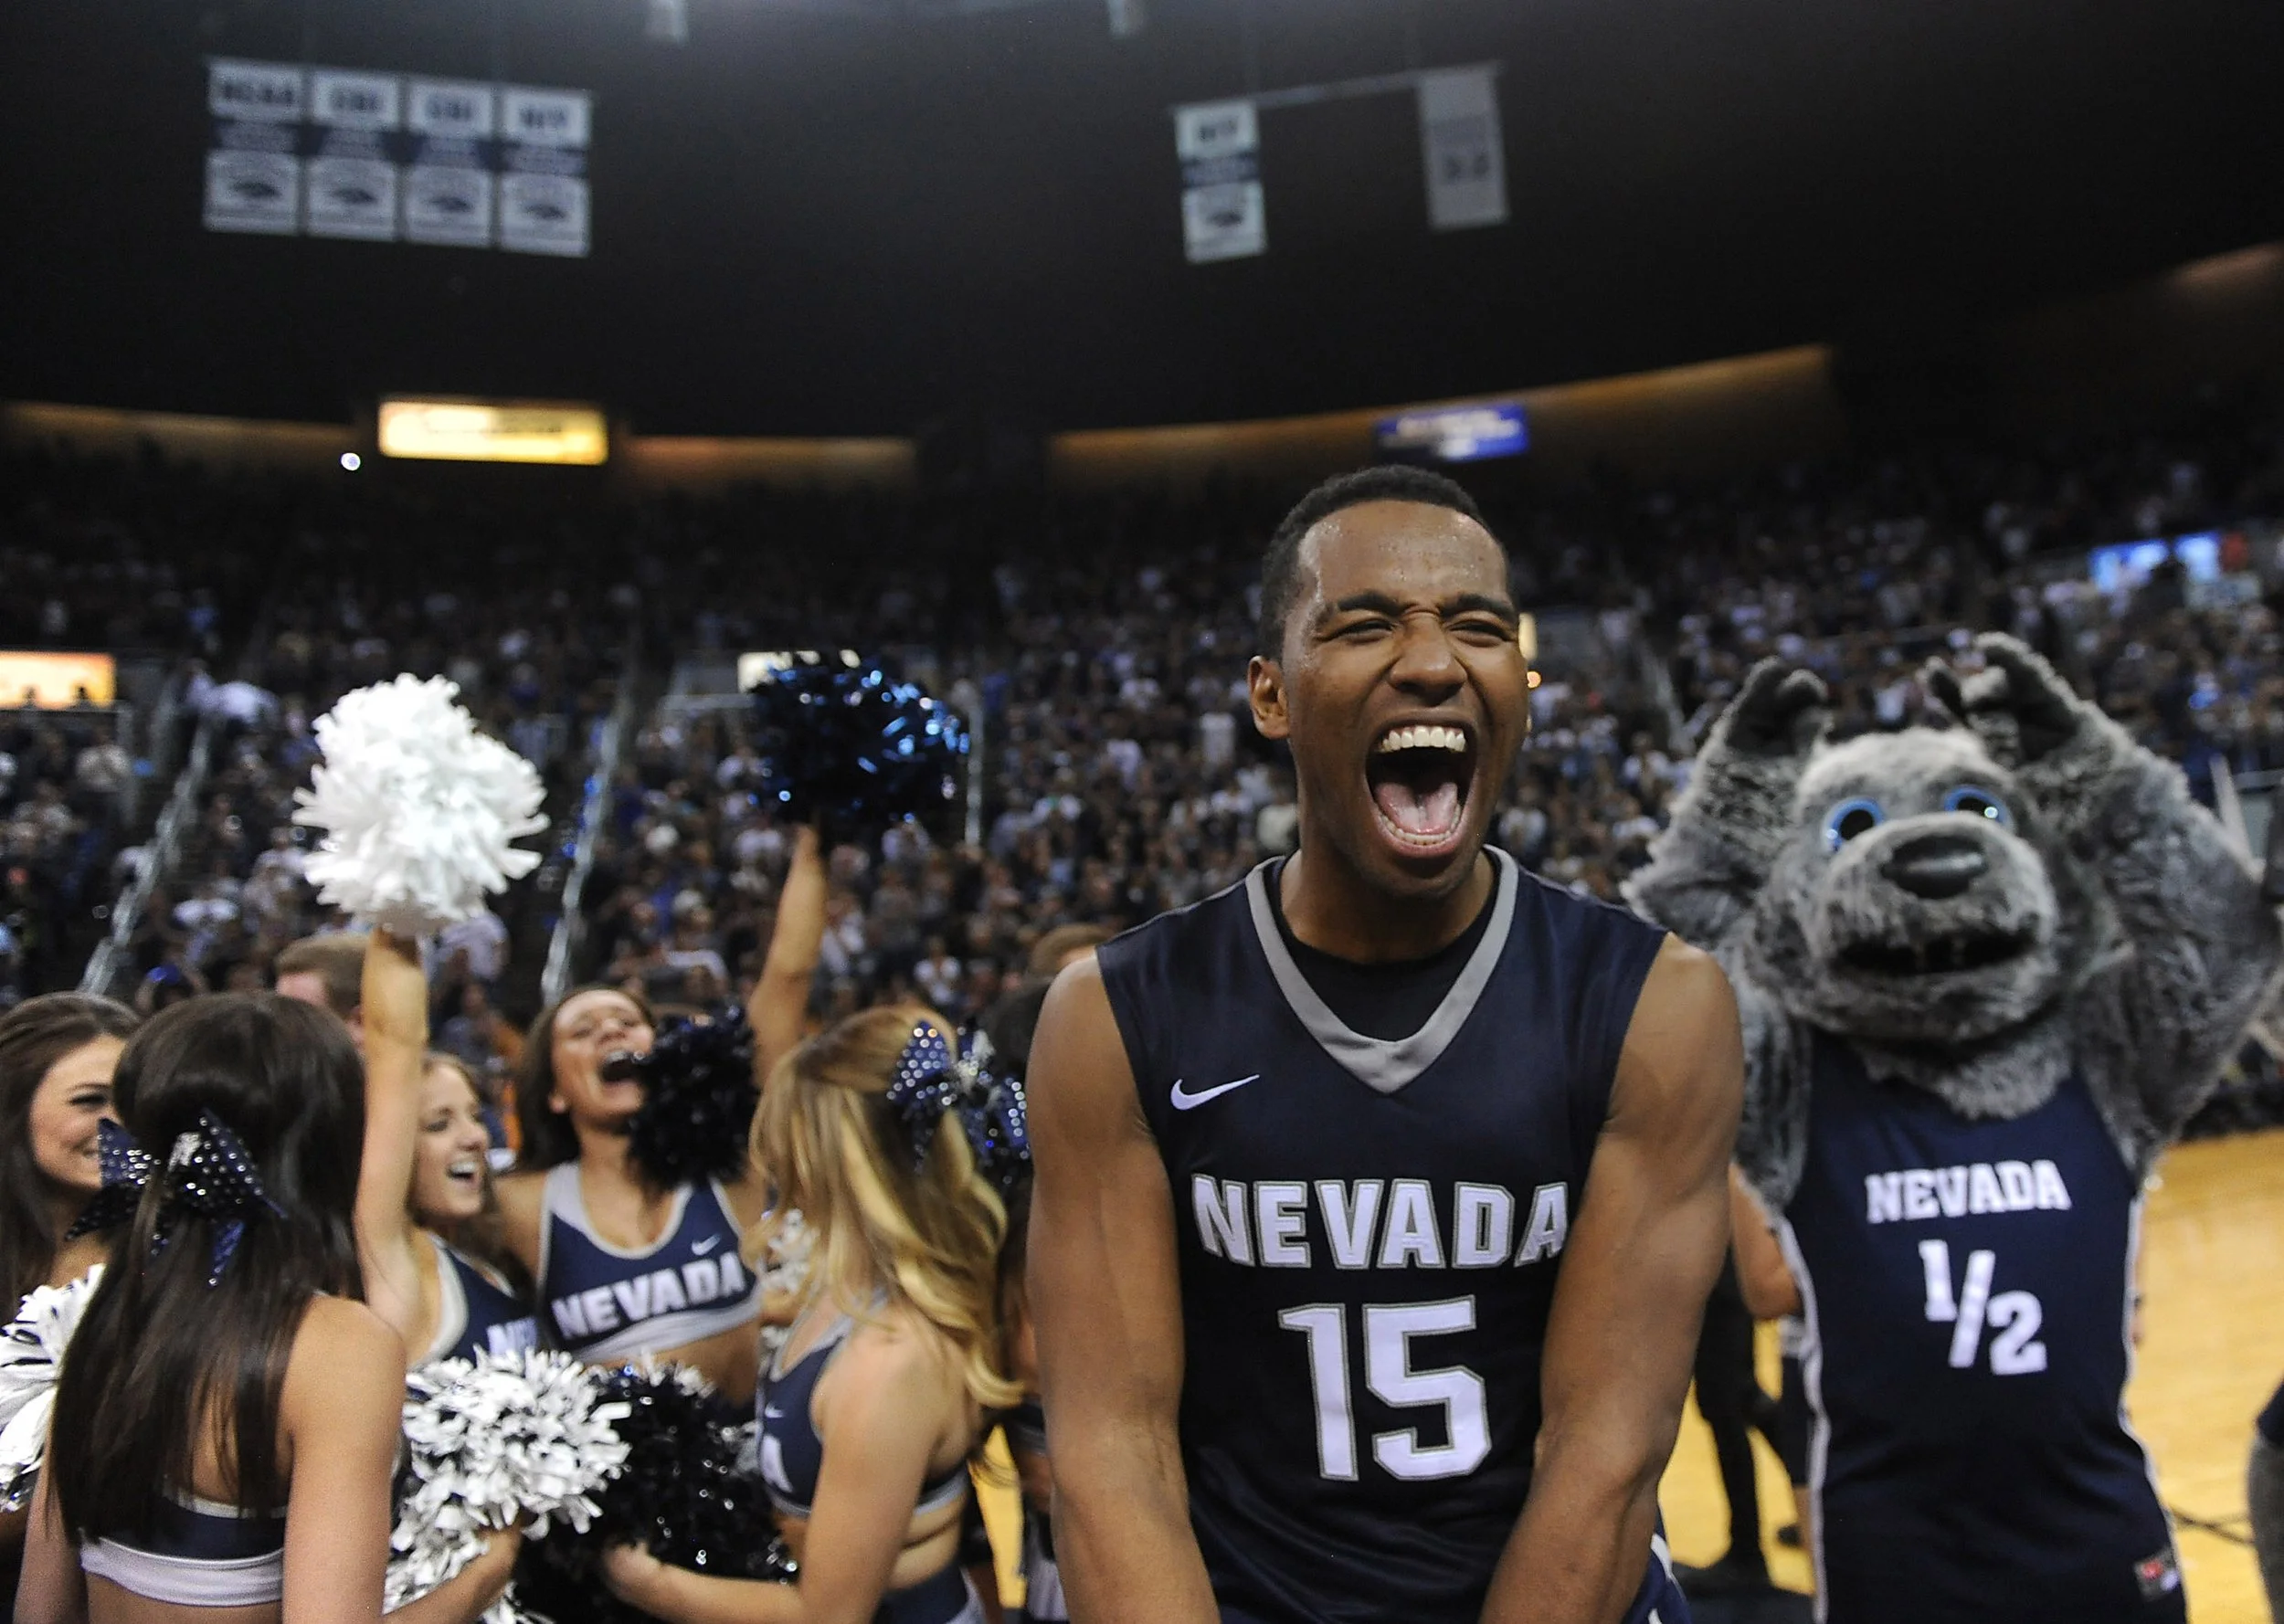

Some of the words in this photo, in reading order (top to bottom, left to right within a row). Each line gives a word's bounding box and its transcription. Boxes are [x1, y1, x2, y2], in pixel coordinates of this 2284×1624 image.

[1191, 1173, 1568, 1269] NEVADA
[1865, 1159, 2071, 1224] NEVADA
[551, 1251, 745, 1341] NEVADA
[1918, 1239, 2047, 1376] 1/2
[1278, 1294, 1492, 1482] 15
